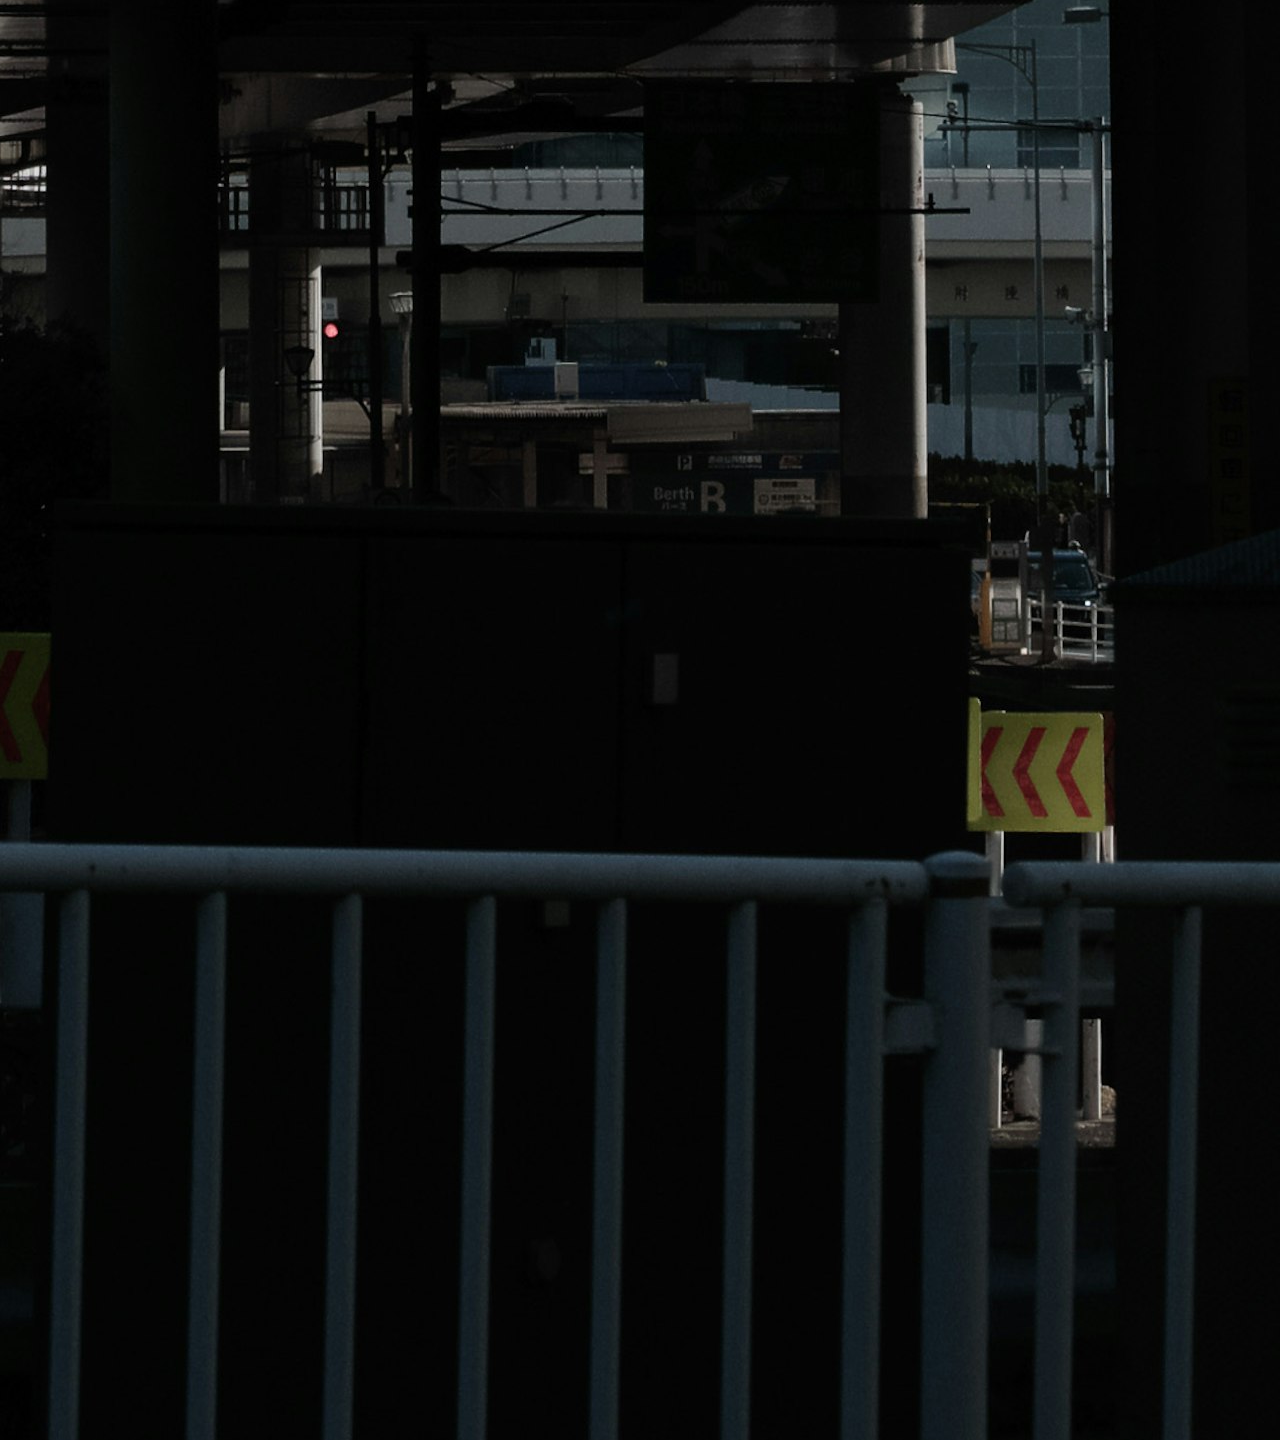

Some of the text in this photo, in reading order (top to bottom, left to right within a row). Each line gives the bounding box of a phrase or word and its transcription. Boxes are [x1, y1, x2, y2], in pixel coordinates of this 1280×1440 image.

[677, 275, 730, 297] 150m
[653, 480, 727, 514] Berth B
